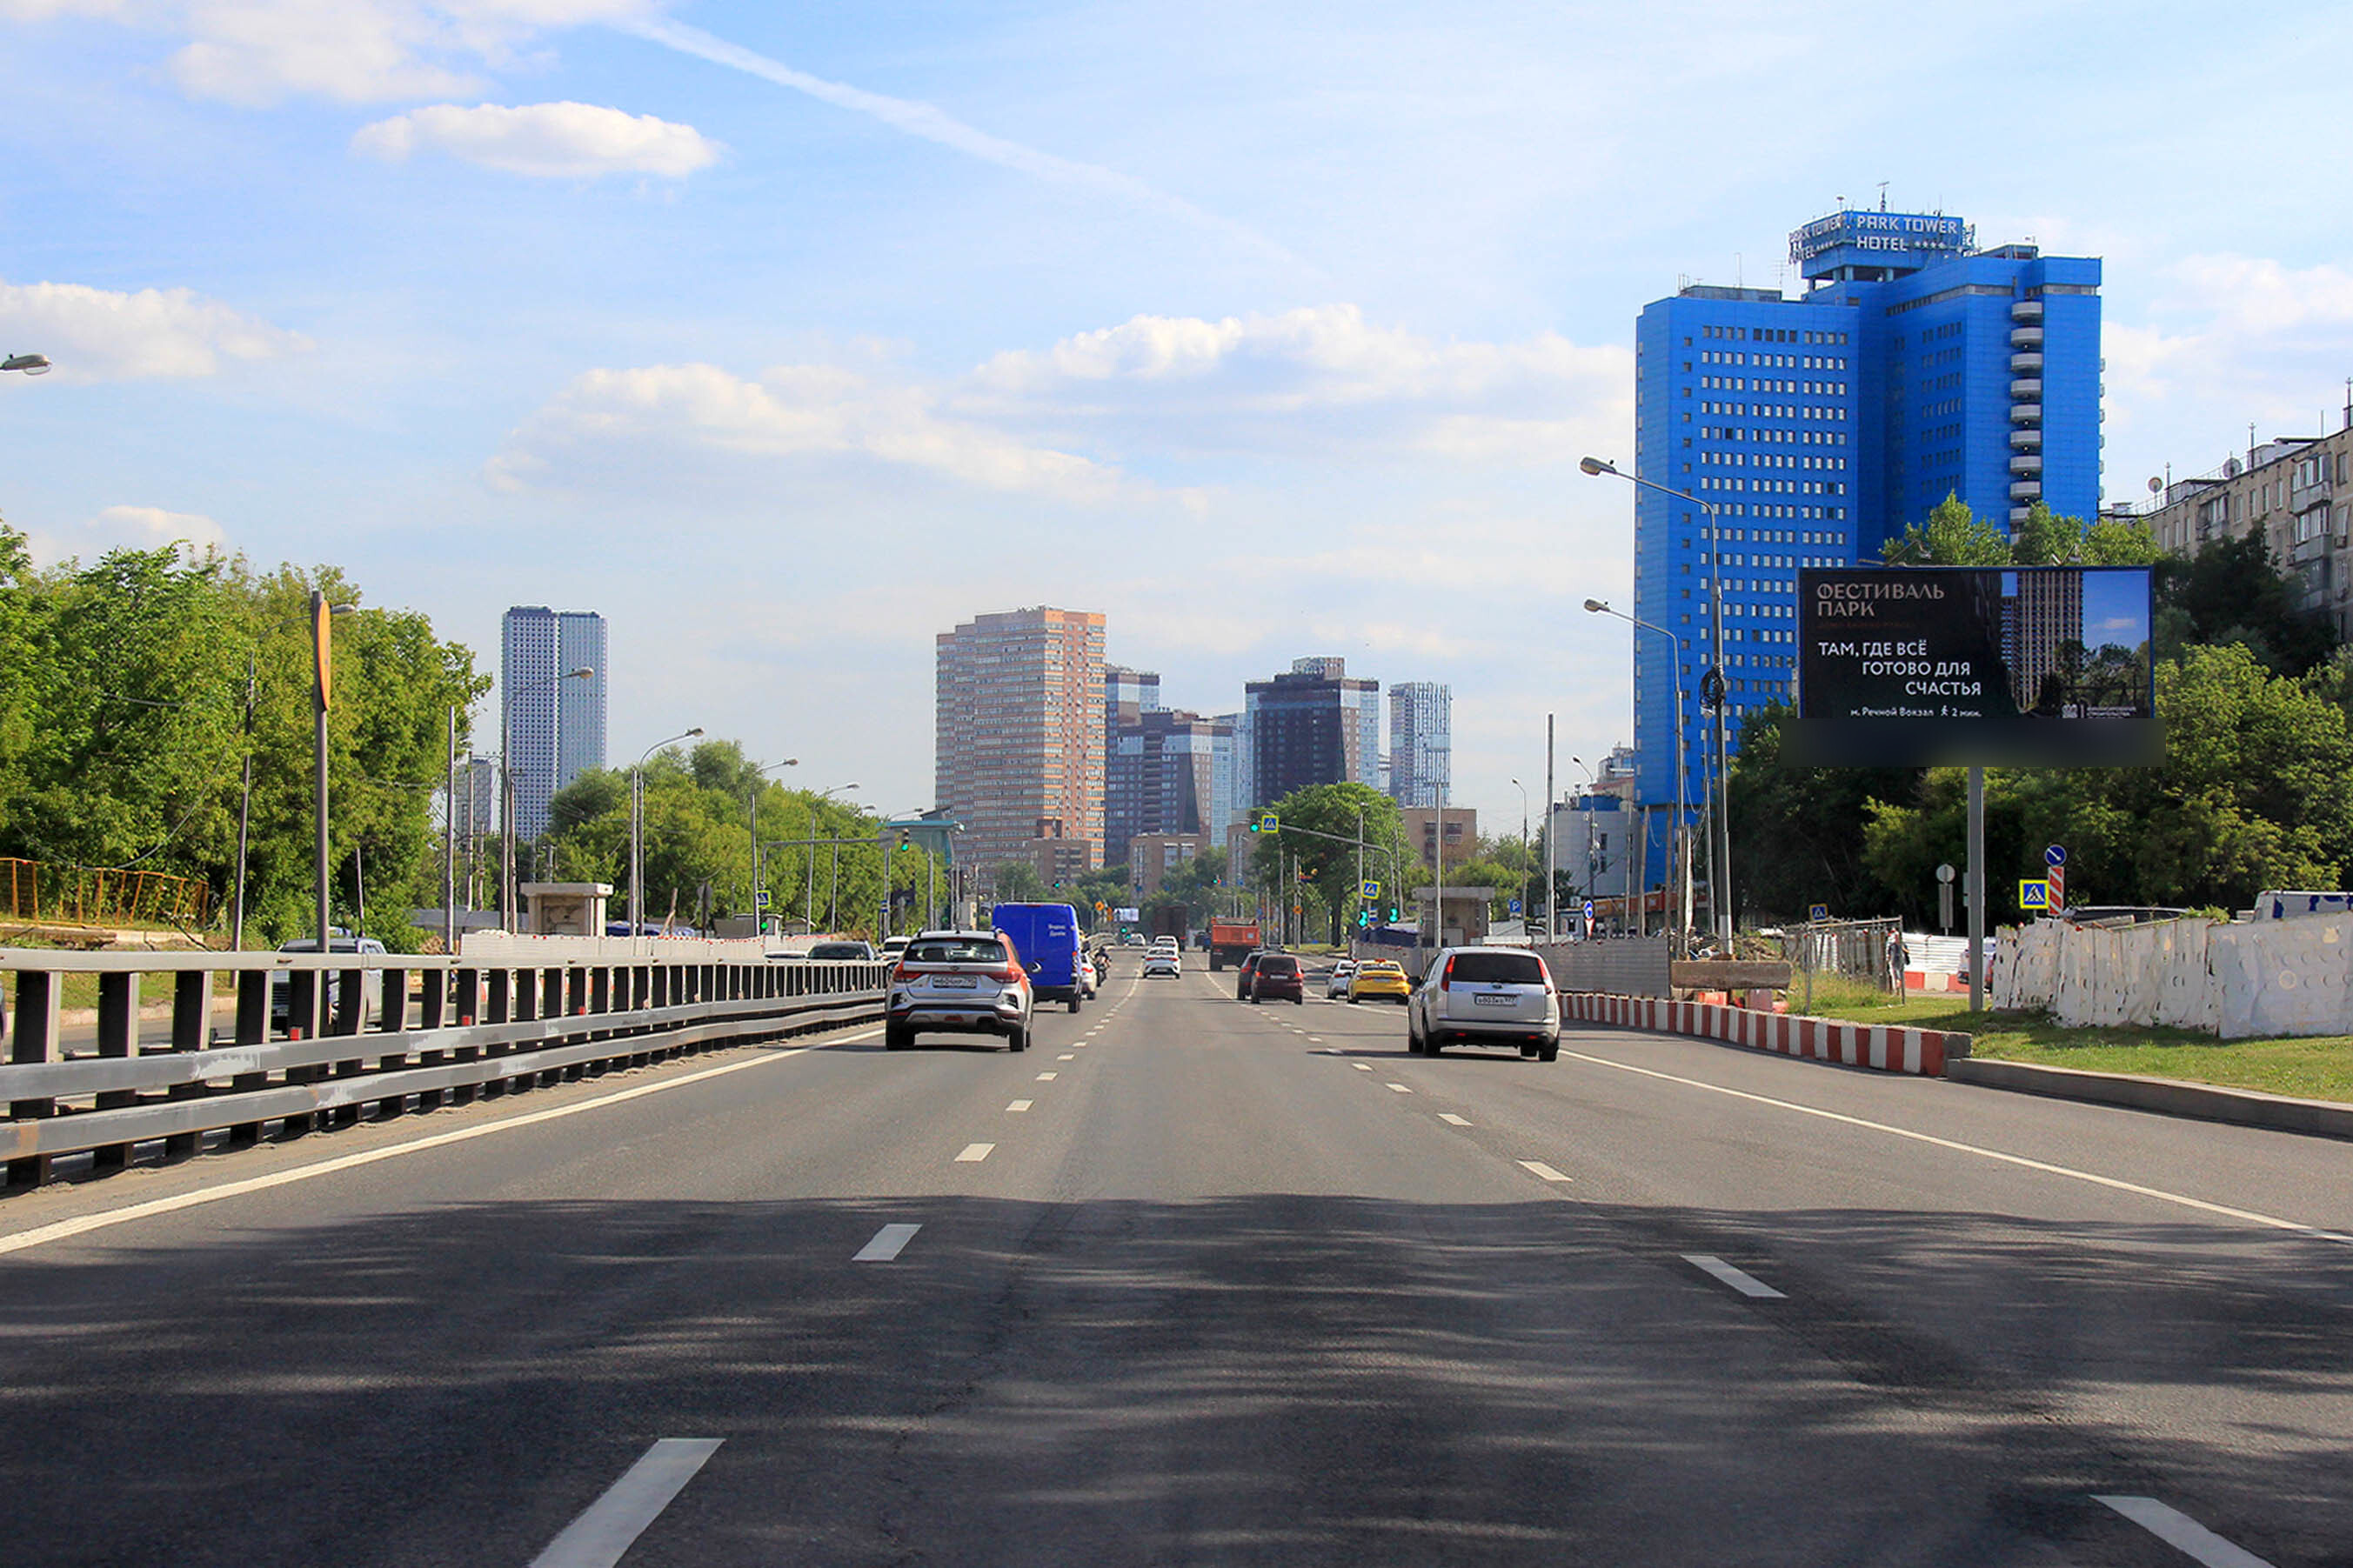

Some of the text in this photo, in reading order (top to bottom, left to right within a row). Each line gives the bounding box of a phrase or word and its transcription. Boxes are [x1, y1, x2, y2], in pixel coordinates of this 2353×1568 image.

[1856, 216, 1958, 234] PARK TOWER
[1856, 236, 1908, 251] HOTEL
[1816, 583, 1945, 599] ФЕСТИВАЛЬ
[1817, 601, 1876, 617] ПАРК
[1818, 639, 1928, 658] ТАМ, ГДЕ ВСЁ
[1862, 661, 1971, 677] ГОТОВО ДЛЯ
[1904, 681, 1982, 696] СЧАСТЬЯ
[1862, 706, 1897, 717] Речной
[1899, 706, 1935, 717] Вокзал
